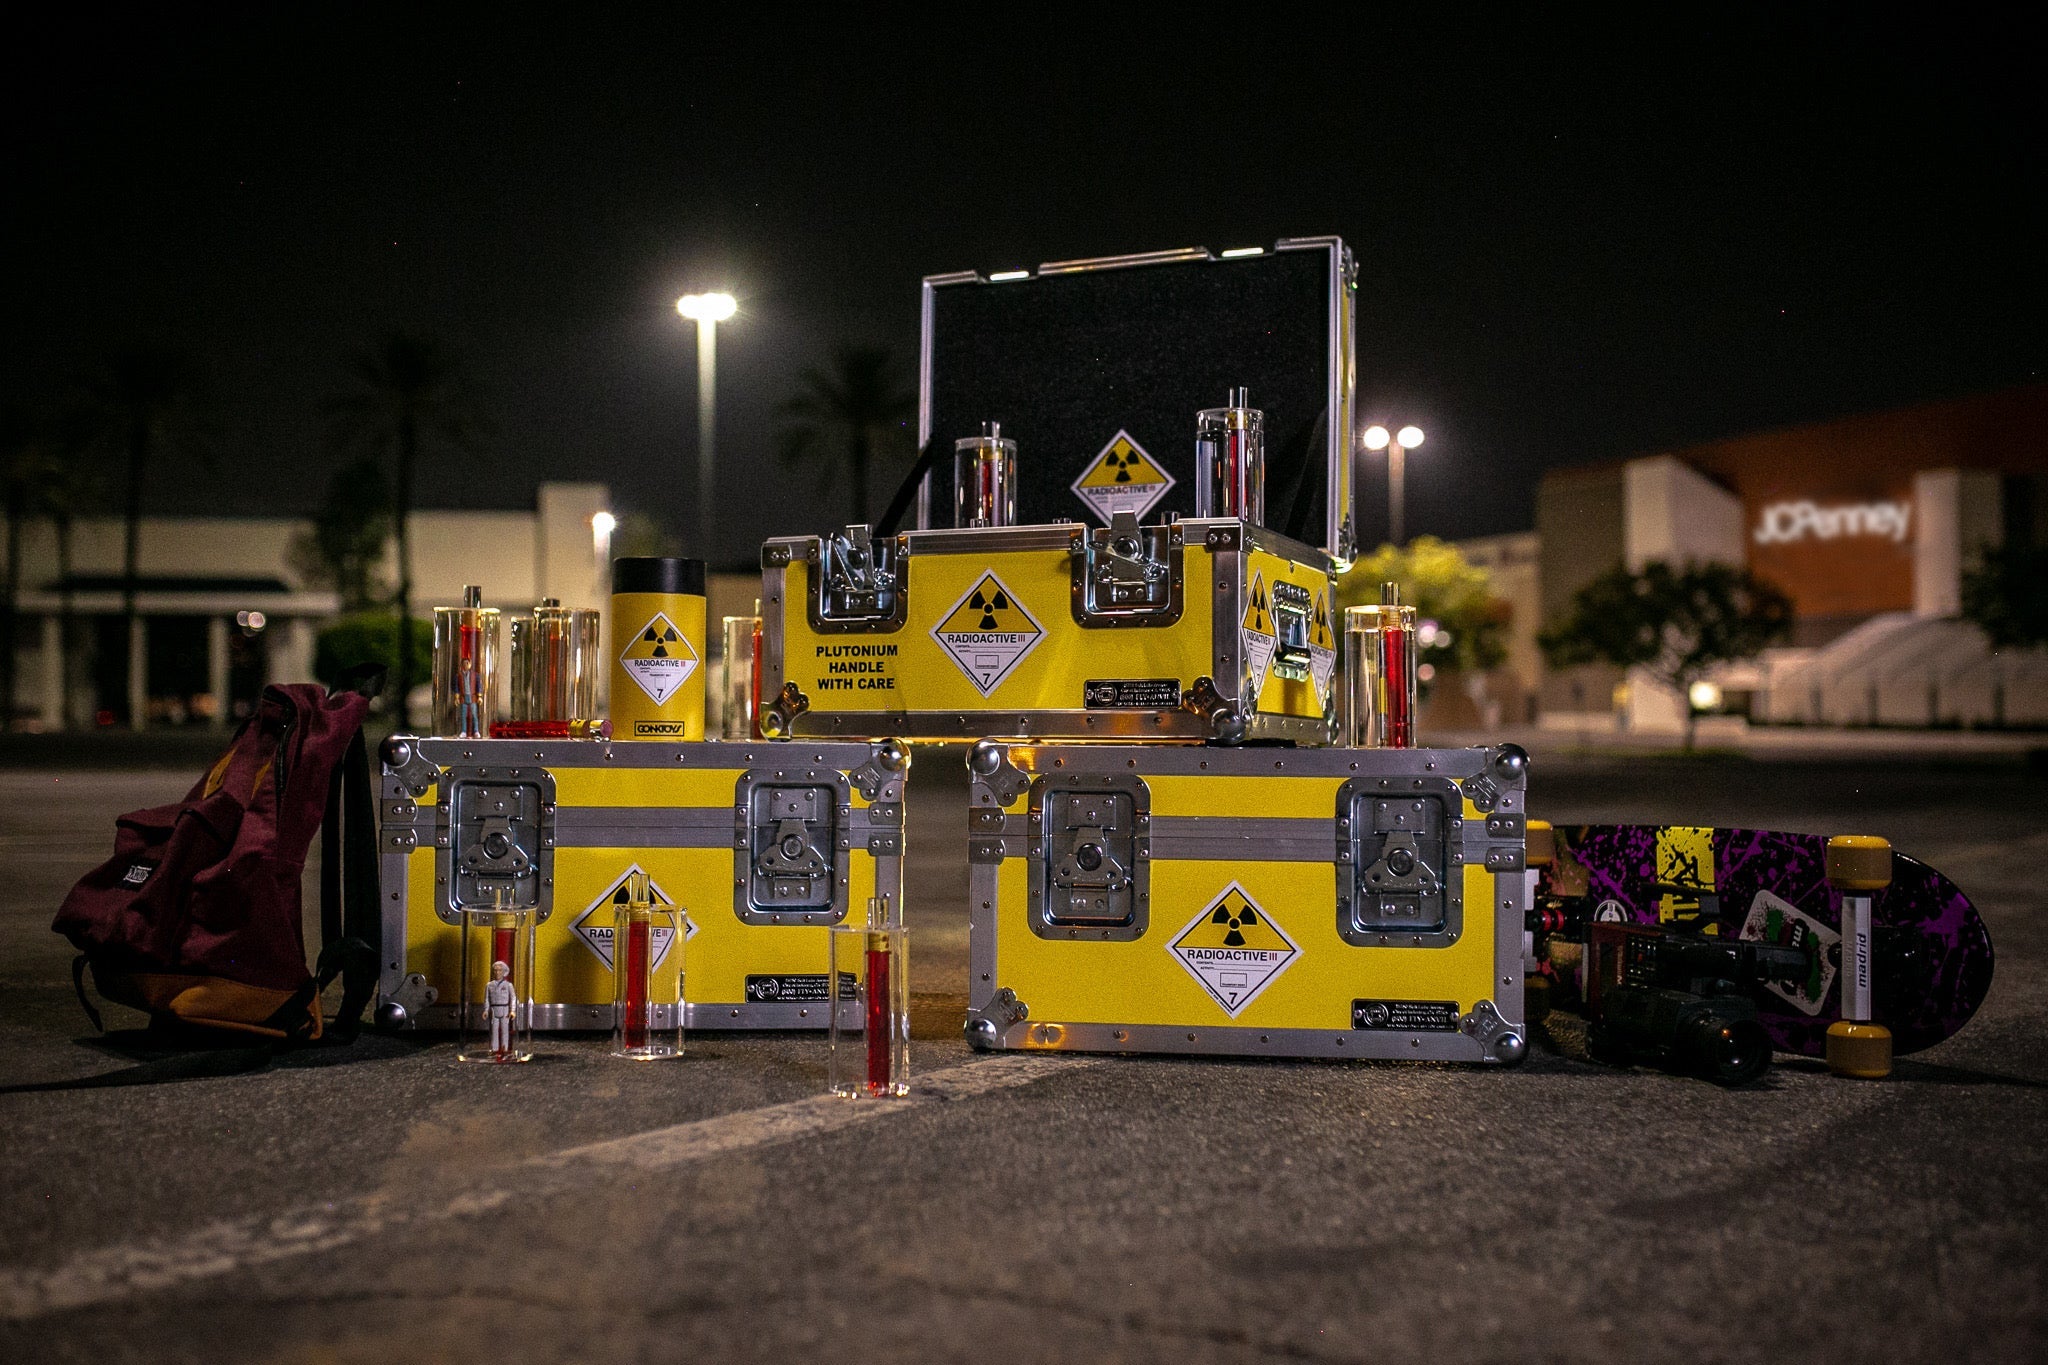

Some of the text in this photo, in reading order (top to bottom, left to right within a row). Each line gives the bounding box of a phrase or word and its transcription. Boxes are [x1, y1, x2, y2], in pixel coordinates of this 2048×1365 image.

[1088, 485, 1148, 495] RADIOACTIVE
[1755, 501, 1910, 544] JCPenney
[948, 634, 1026, 643] RADIOACTIVE III
[816, 645, 898, 657] PLUTONIUM
[634, 659, 680, 667] RADIOACTIVE
[829, 662, 884, 673] HANDLE
[817, 678, 895, 690] WITH CARE
[982, 673, 991, 685] 7
[657, 688, 664, 699] 7
[637, 725, 682, 733] GONKTOYS
[1187, 949, 1278, 961] RADIOACTIVE III
[1856, 933, 1867, 988] madrid
[1229, 992, 1238, 1004] 7
